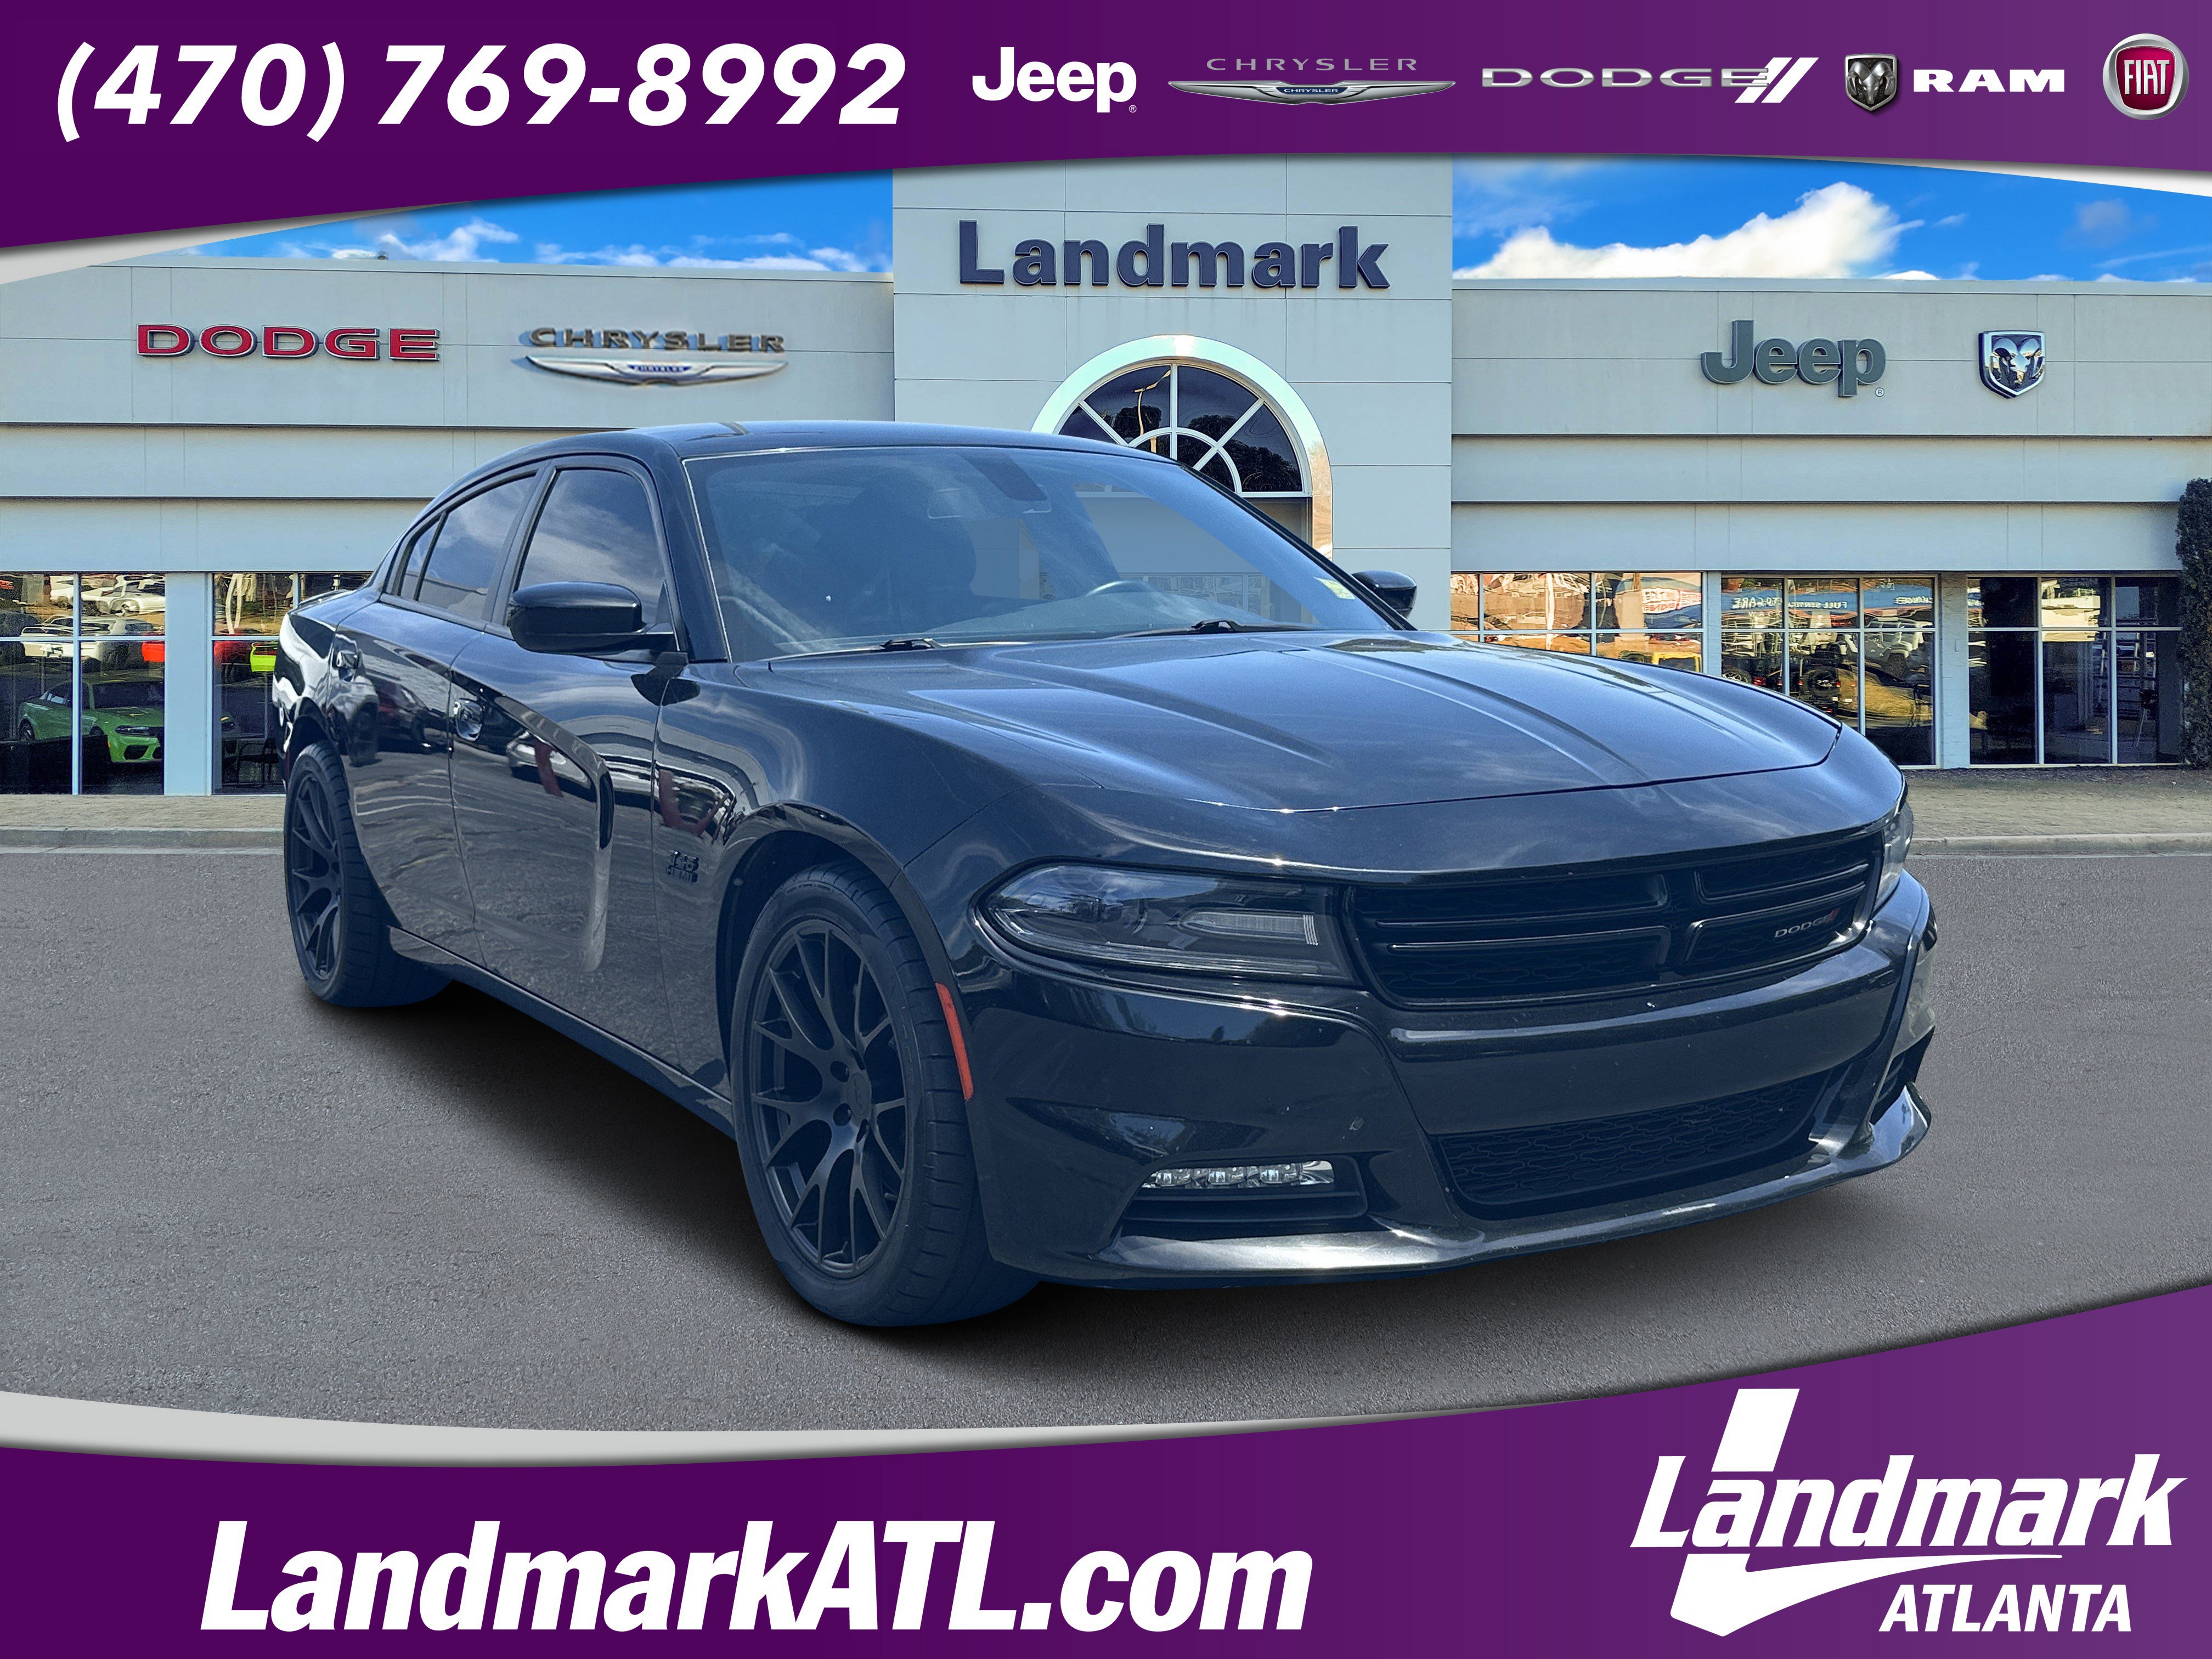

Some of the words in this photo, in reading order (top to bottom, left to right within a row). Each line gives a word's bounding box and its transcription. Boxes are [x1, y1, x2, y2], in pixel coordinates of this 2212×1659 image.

[959, 220, 1391, 289] Landmark
[136, 323, 439, 361] DODGE
[529, 327, 786, 353] CHRYSLER
[1700, 319, 1886, 398] Jeep
